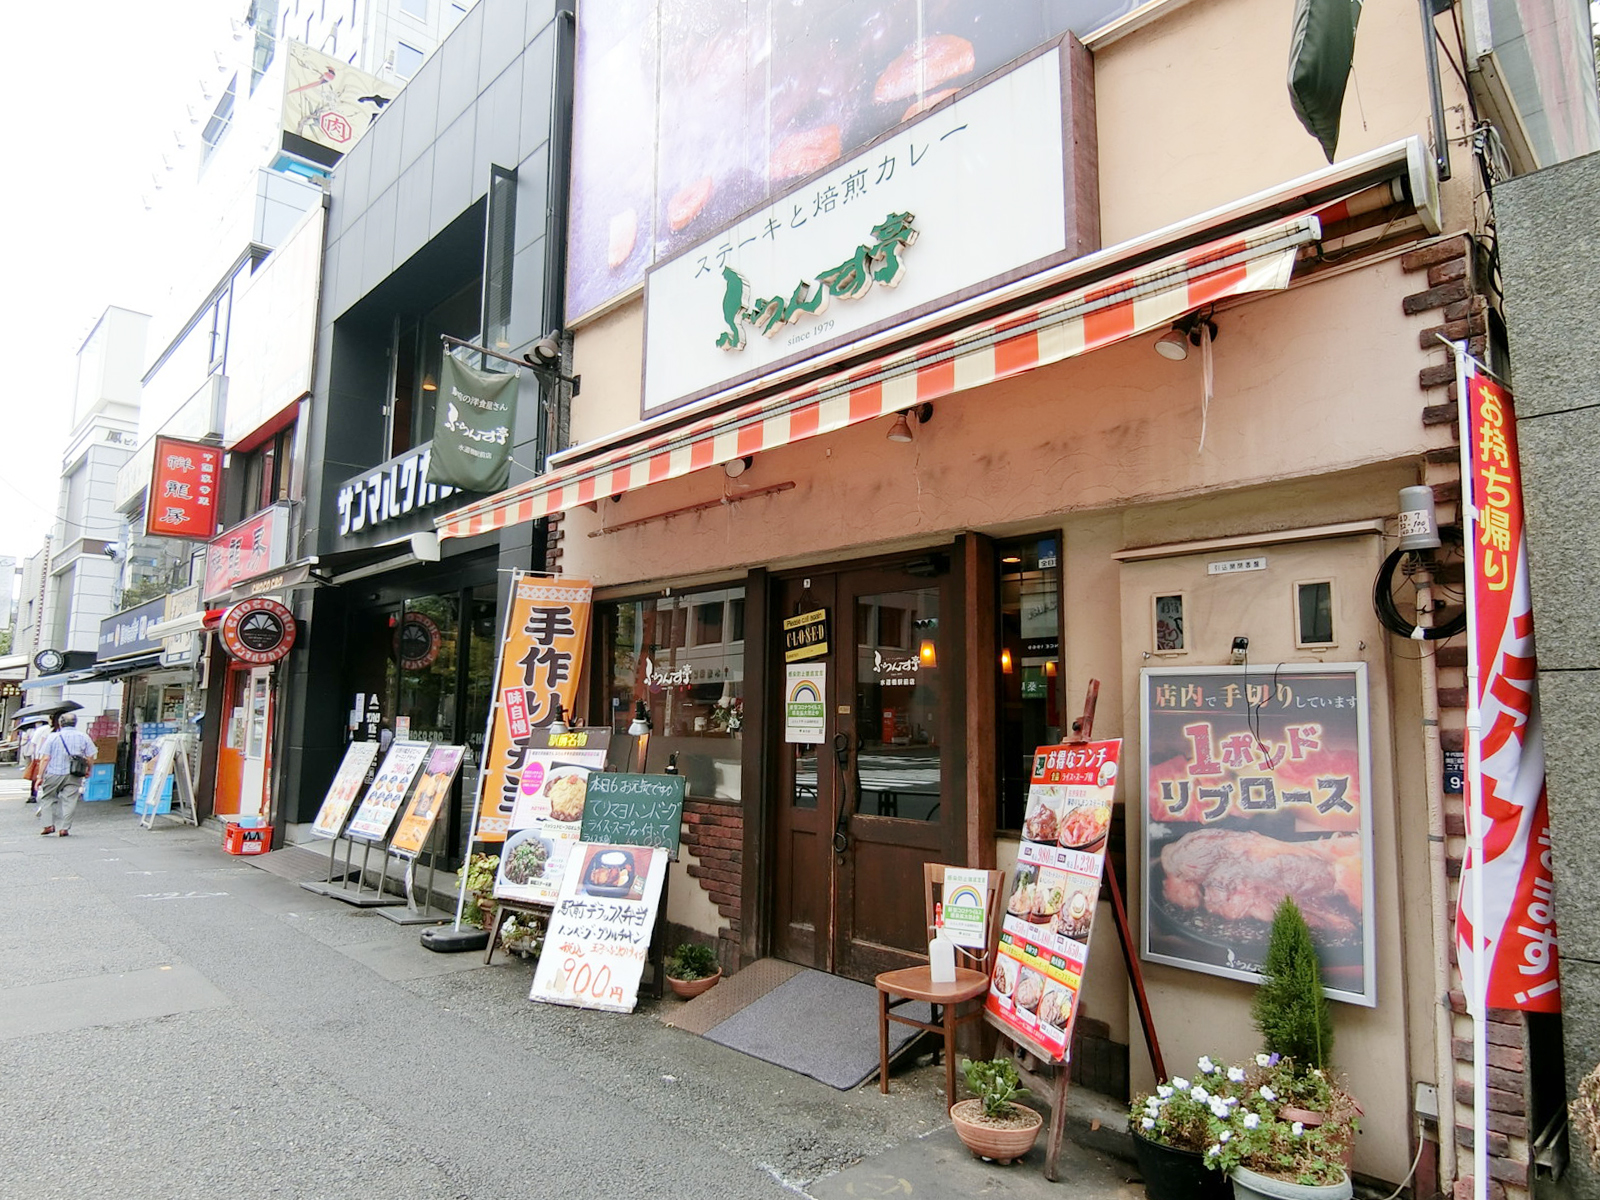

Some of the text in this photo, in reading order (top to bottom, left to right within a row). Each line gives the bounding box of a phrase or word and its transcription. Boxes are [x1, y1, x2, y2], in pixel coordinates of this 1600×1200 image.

[327, 117, 347, 140] 肉
[694, 122, 969, 279] ステーキと焙煎カレー
[716, 211, 920, 352] ふらんす亭
[787, 319, 836, 347] since 1979
[445, 402, 509, 446] ふらんす亭
[337, 450, 464, 536] サンマルクカ
[1478, 386, 1511, 592] お持ち帰り
[643, 657, 693, 686] ふらんす亭
[872, 650, 921, 673] ふらんす亭
[507, 692, 527, 735] 味自慢
[1155, 683, 1357, 709] 店内で手切りしています
[1047, 747, 1107, 770] お得なランチ
[1183, 722, 1322, 776] 1ポンド
[1160, 775, 1355, 821] リブロース
[557, 899, 649, 926] 駅前デラックス弁当
[563, 957, 624, 1004] 900円
